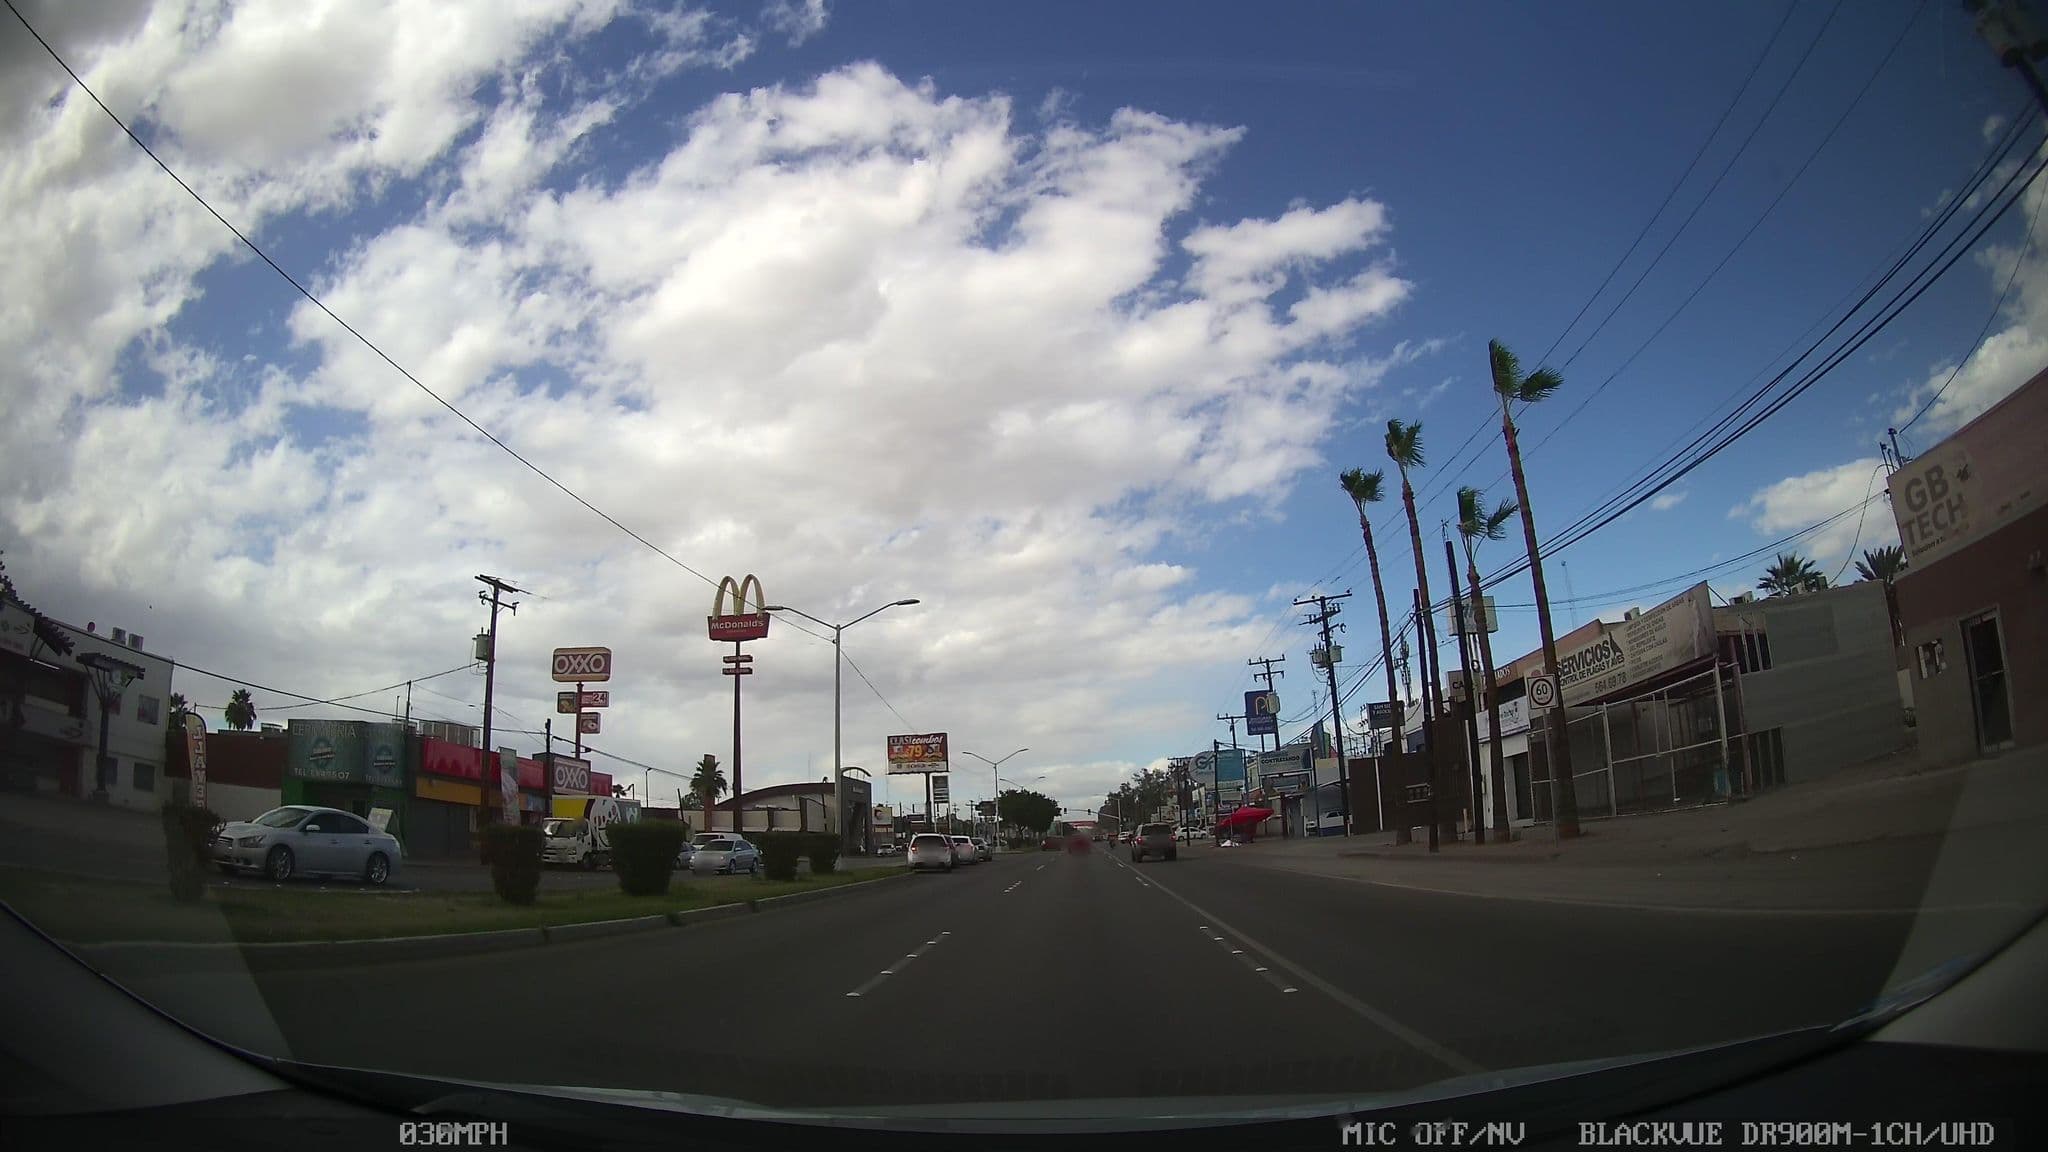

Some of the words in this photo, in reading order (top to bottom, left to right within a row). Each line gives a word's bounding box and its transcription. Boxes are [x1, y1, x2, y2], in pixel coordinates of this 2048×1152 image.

[1904, 464, 1949, 512] GB
[1902, 492, 1968, 545] TECH
[554, 653, 605, 674] OXXO
[1556, 640, 1611, 677] SERVICIOS
[593, 694, 605, 702] 24
[1535, 683, 1549, 696] 60
[555, 765, 588, 790] OXXO
